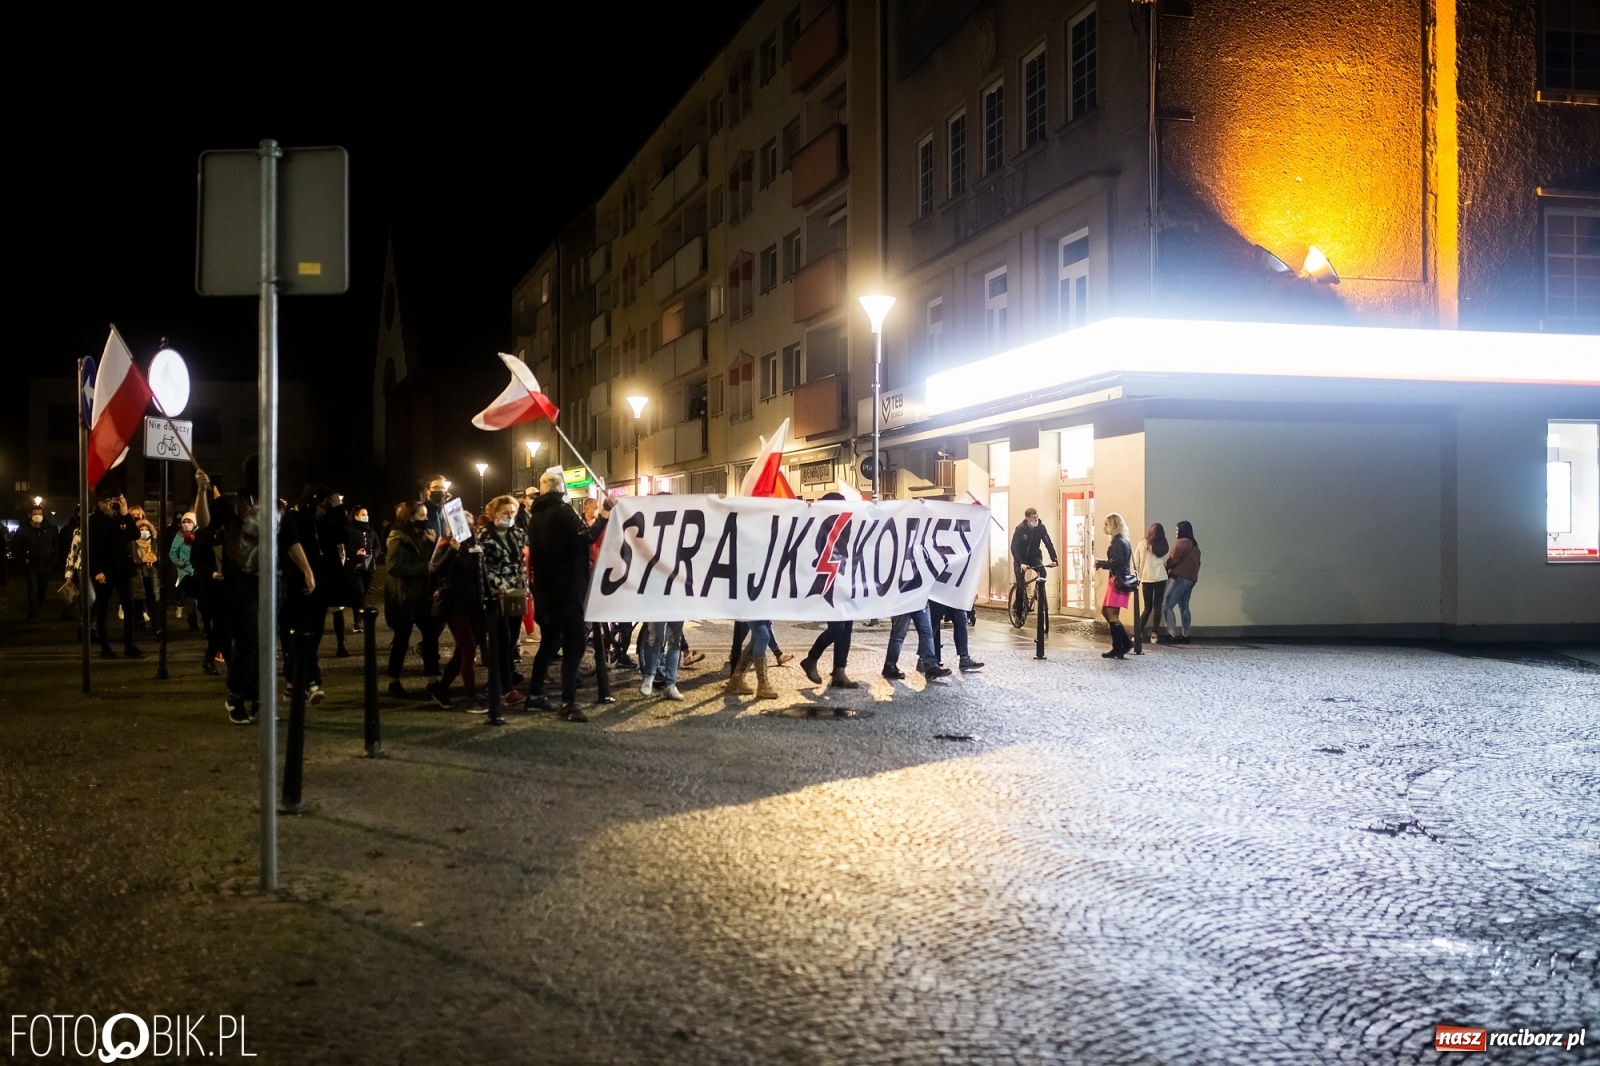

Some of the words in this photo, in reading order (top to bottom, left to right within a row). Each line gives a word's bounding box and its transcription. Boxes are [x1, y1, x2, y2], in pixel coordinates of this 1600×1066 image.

[891, 393, 903, 409] TEB
[148, 420, 161, 429] Nie
[163, 422, 190, 435] doyczy
[600, 509, 815, 601] STRAJK
[849, 517, 972, 600] KOBIET
